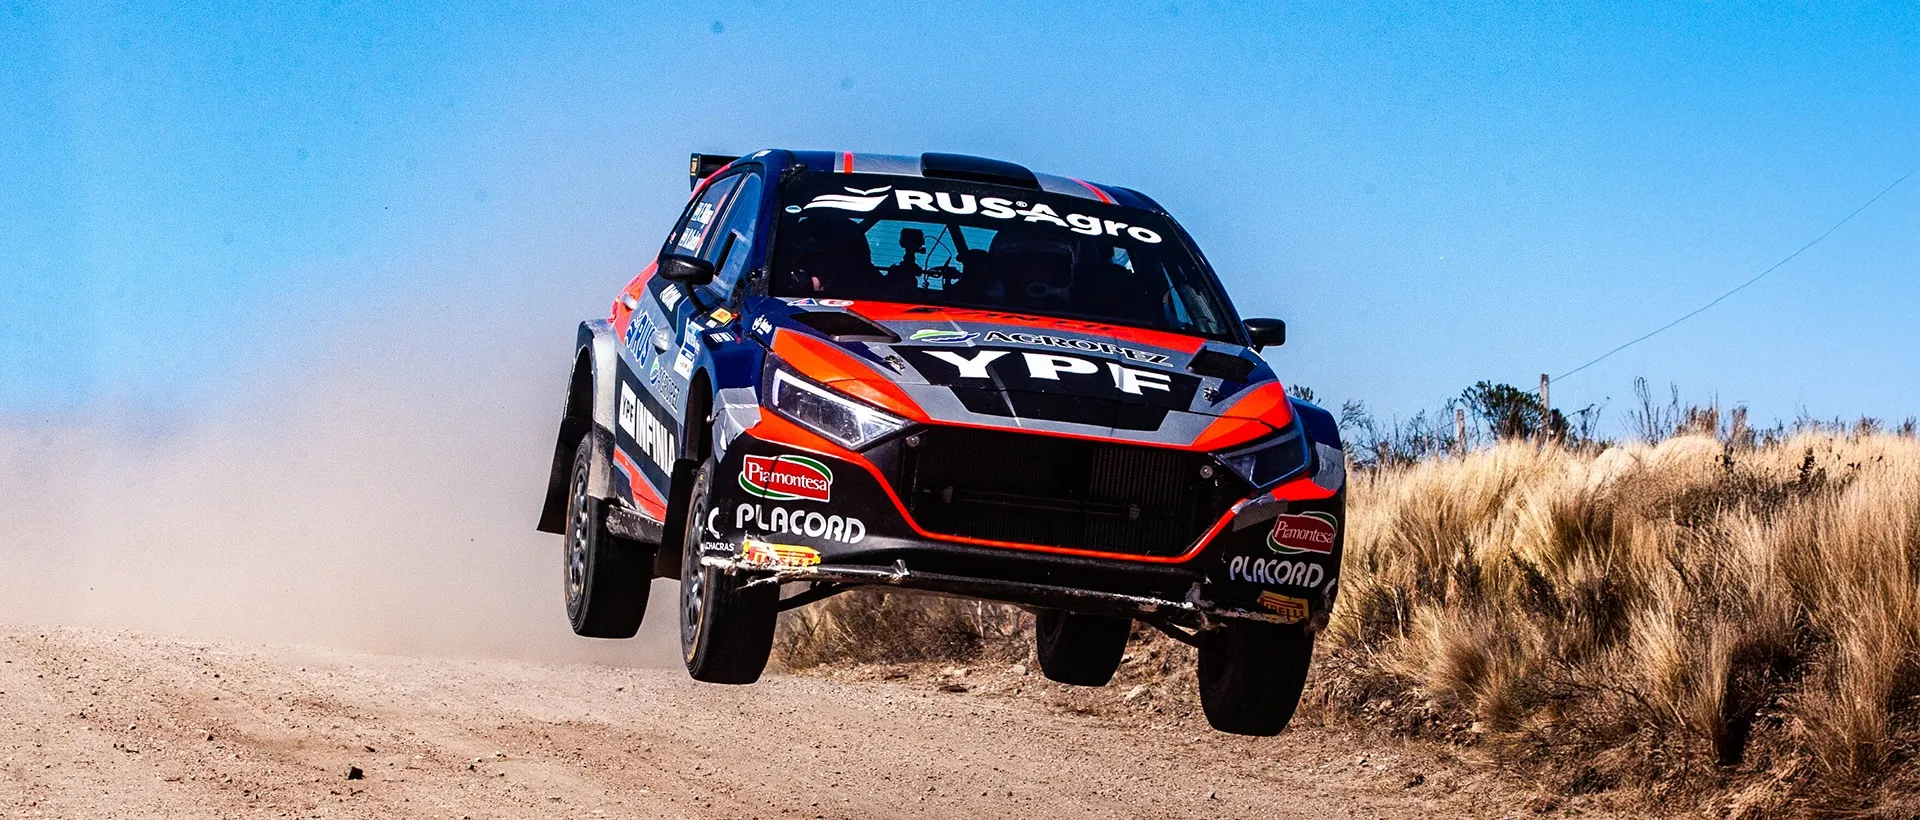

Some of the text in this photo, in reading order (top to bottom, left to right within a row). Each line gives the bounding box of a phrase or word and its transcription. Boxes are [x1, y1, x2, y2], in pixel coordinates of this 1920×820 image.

[984, 331, 1174, 367] AGROPEZ
[921, 350, 1172, 395] YPF
[622, 394, 634, 423] YPF
[747, 460, 828, 492] Piamontesa
[735, 503, 866, 544] PLACORD
[1274, 520, 1334, 544] Piamontesa
[1229, 555, 1325, 588] PLACORD
